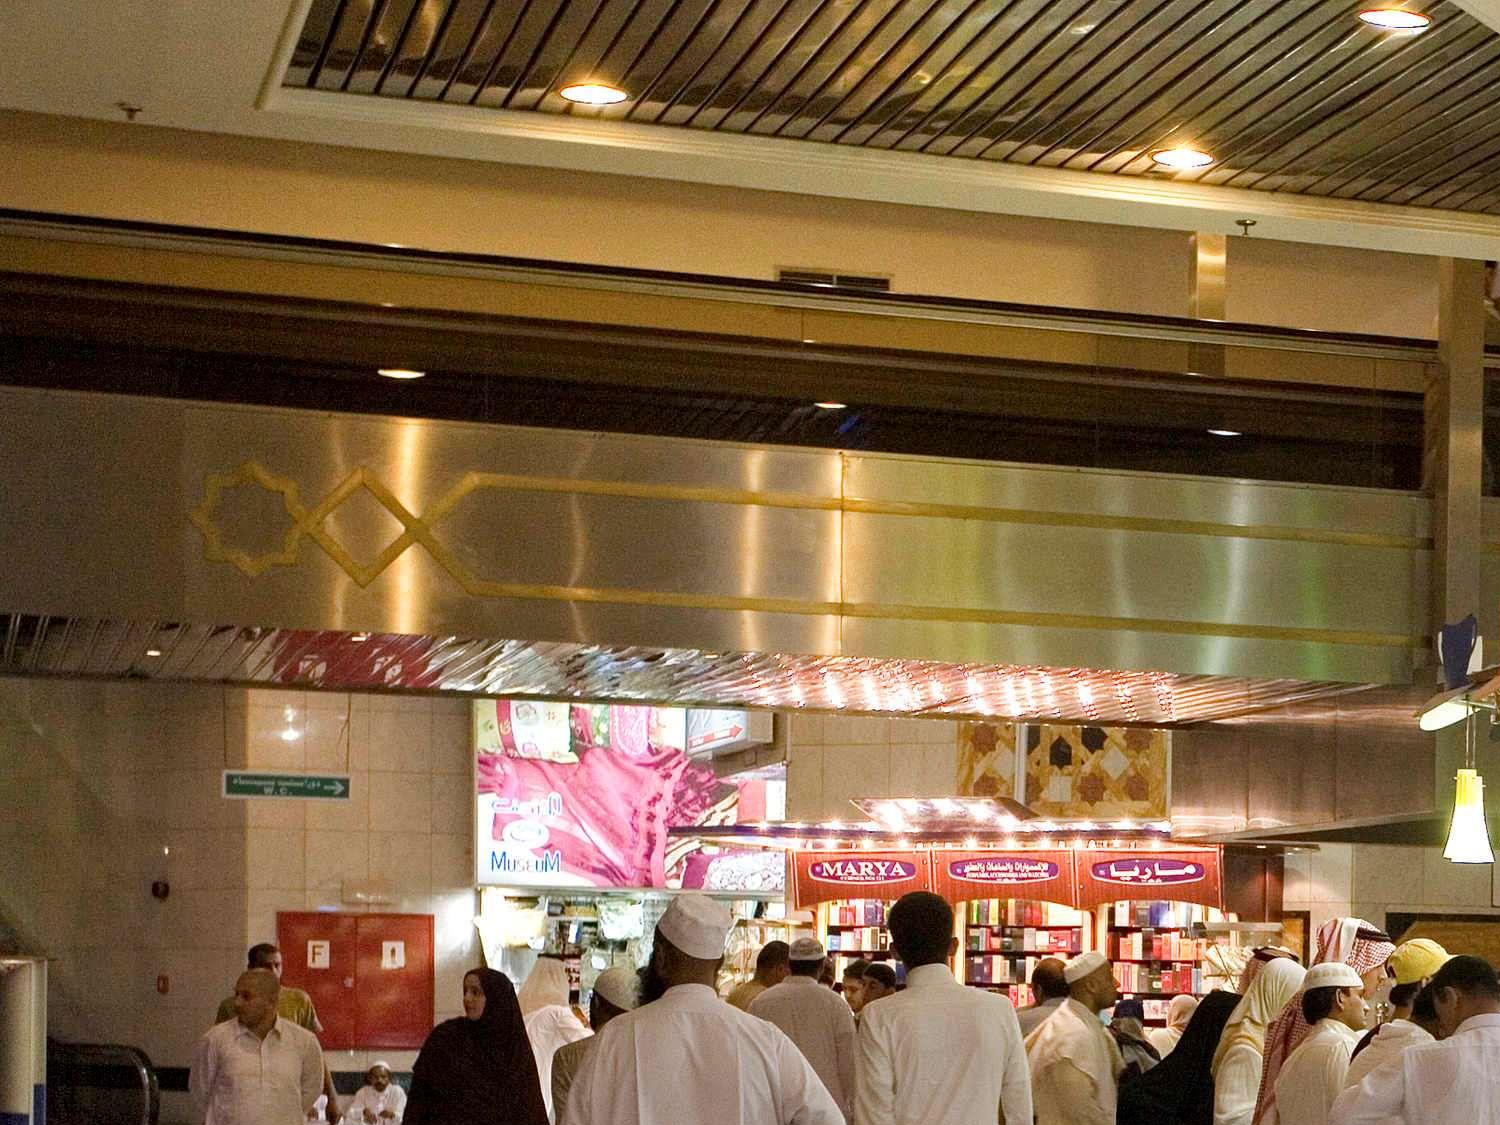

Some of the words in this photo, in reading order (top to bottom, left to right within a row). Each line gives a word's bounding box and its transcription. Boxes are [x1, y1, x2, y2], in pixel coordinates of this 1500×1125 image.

[821, 861, 907, 877] MARYA
[1109, 862, 1196, 881] ماريا
[311, 943, 325, 964] F
